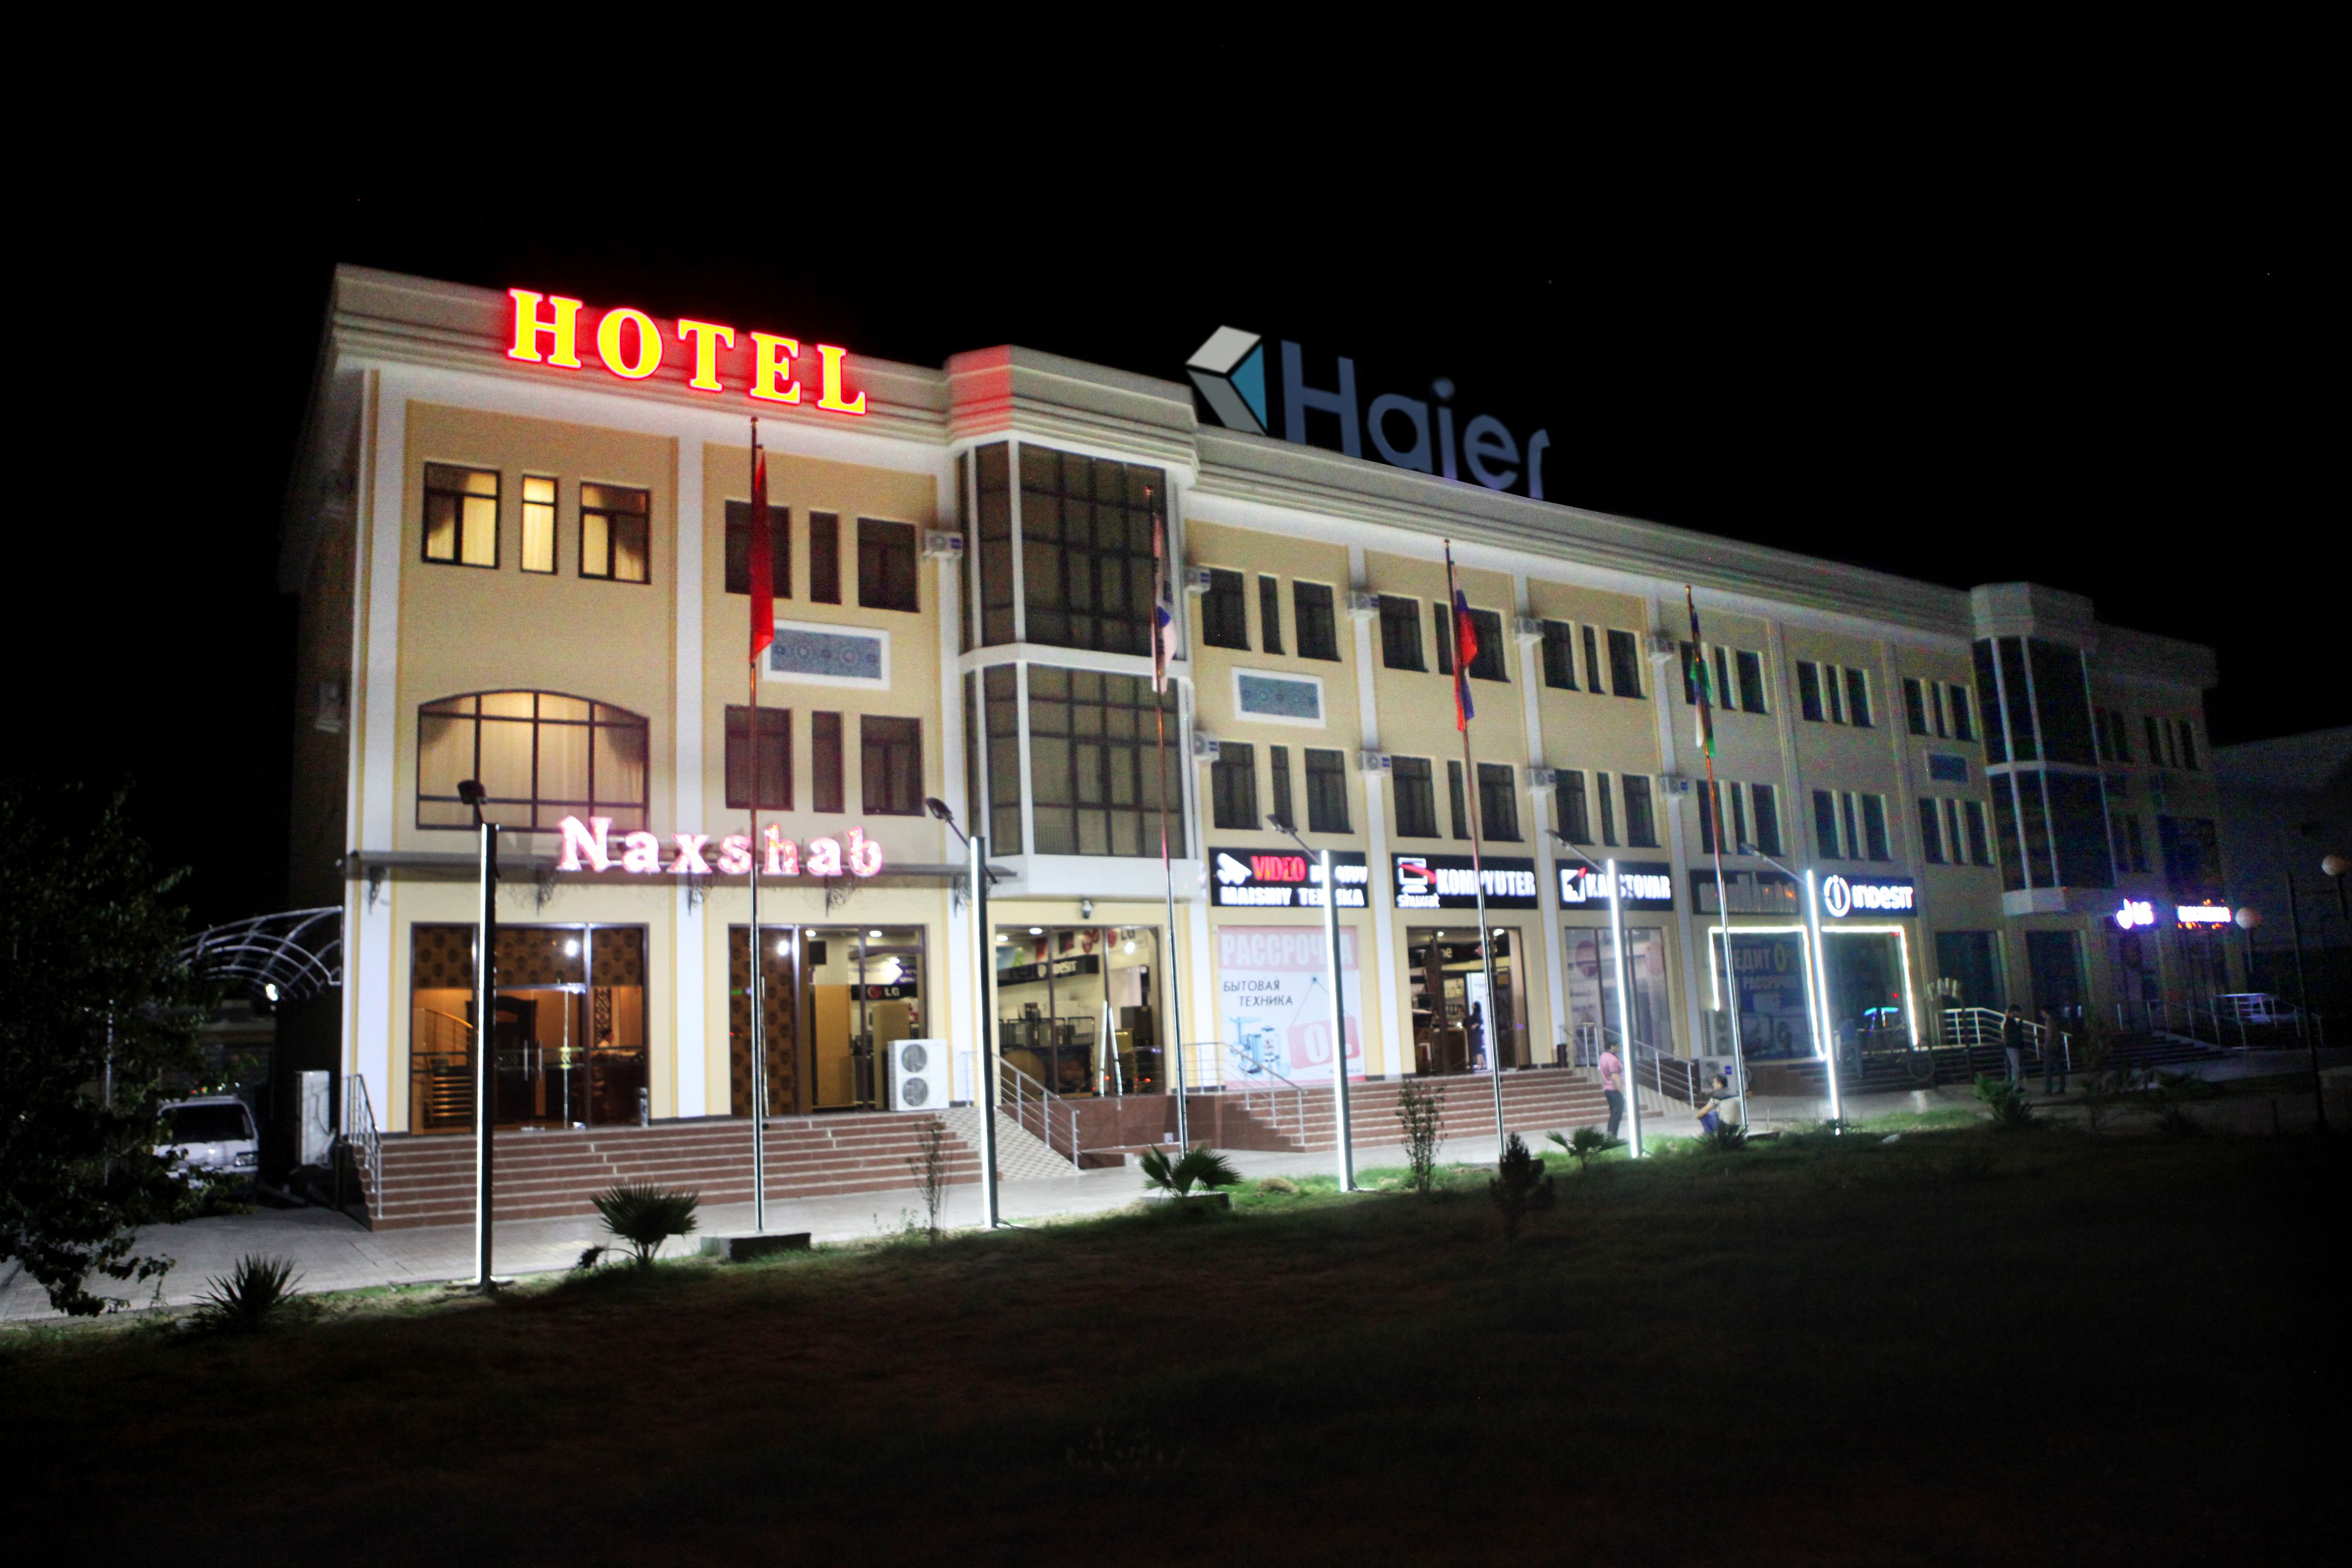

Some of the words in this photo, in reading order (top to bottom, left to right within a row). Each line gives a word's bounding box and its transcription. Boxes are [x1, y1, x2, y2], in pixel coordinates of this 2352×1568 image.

[507, 287, 868, 415] HOTEL
[1281, 339, 1551, 500] Haier
[557, 815, 882, 877] Naxshab
[1251, 855, 1306, 882] VIDEO
[1434, 868, 1537, 897] KOMPYUTER
[1219, 886, 1292, 907] MAISHIY
[1584, 872, 1672, 900] KASTOVAR
[1221, 933, 1354, 967] РАССРОЧА
[884, 986, 900, 997] LG
[1223, 979, 1281, 992] БЫТОВАЯ
[1239, 995, 1294, 1007] ТЕХНИКА
